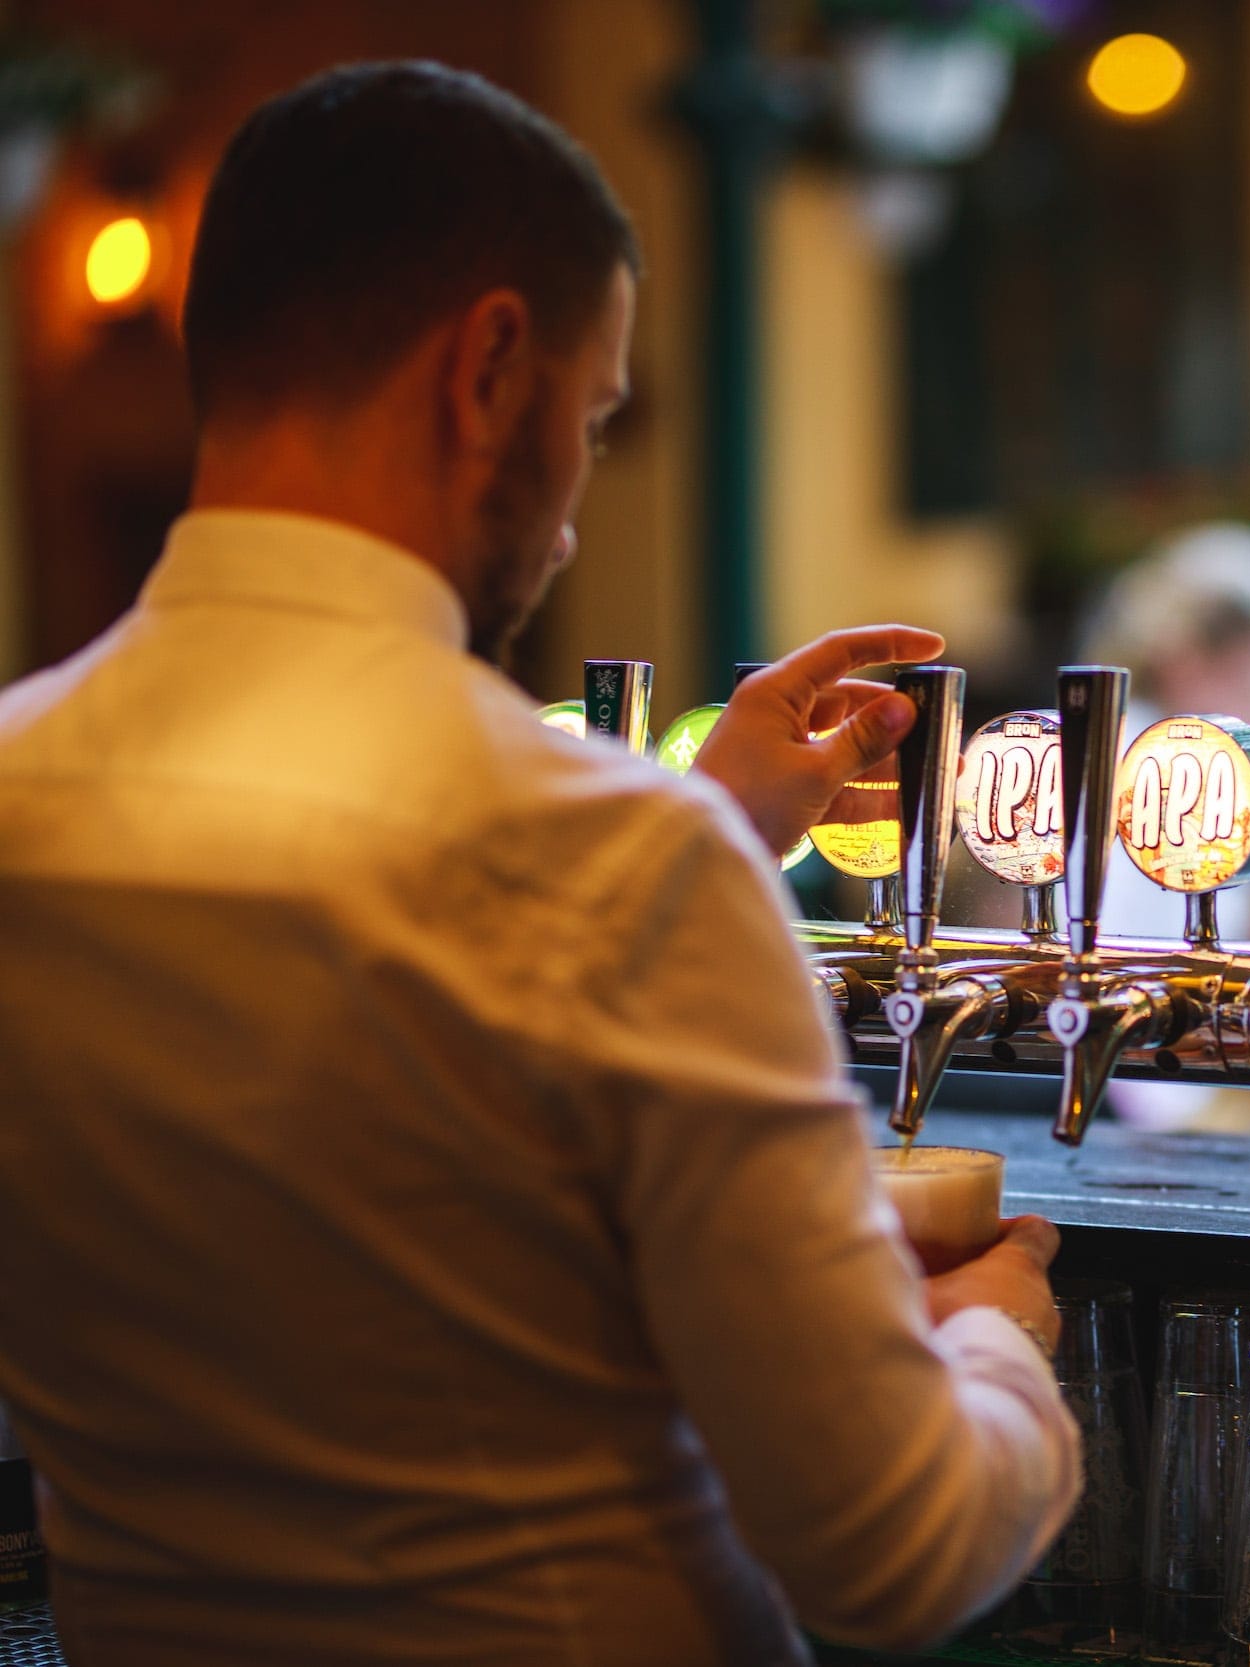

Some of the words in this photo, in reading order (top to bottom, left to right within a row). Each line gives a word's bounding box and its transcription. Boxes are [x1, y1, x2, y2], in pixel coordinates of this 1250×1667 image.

[1006, 723, 1040, 737] BRON
[975, 744, 1061, 843] IPA
[1130, 750, 1236, 850] APA
[845, 823, 882, 833] HELL
